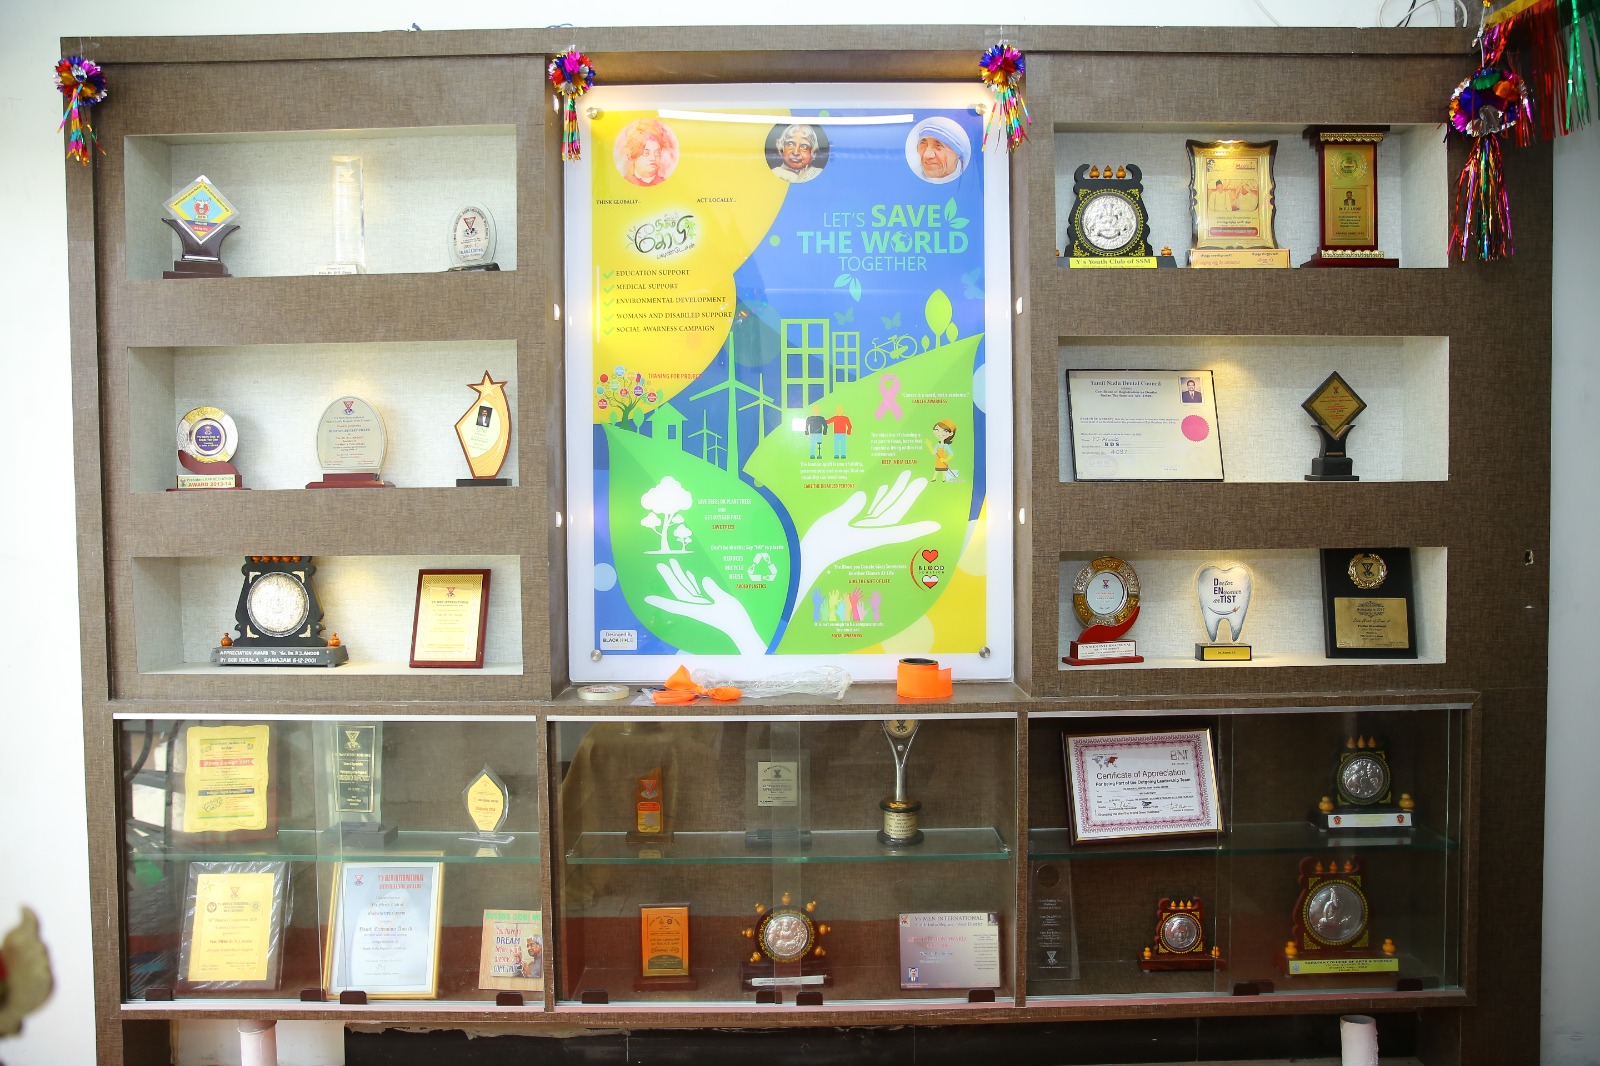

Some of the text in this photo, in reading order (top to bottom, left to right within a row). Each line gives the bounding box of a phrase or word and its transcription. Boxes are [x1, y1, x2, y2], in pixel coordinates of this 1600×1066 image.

[823, 204, 942, 228] LET'S SAVE
[796, 230, 969, 254] THE WORLD
[838, 256, 927, 271] TOGETHER
[1096, 772, 1132, 780] Certificate
[1142, 768, 1186, 778] Appreciation
[496, 936, 520, 944] DREAM
